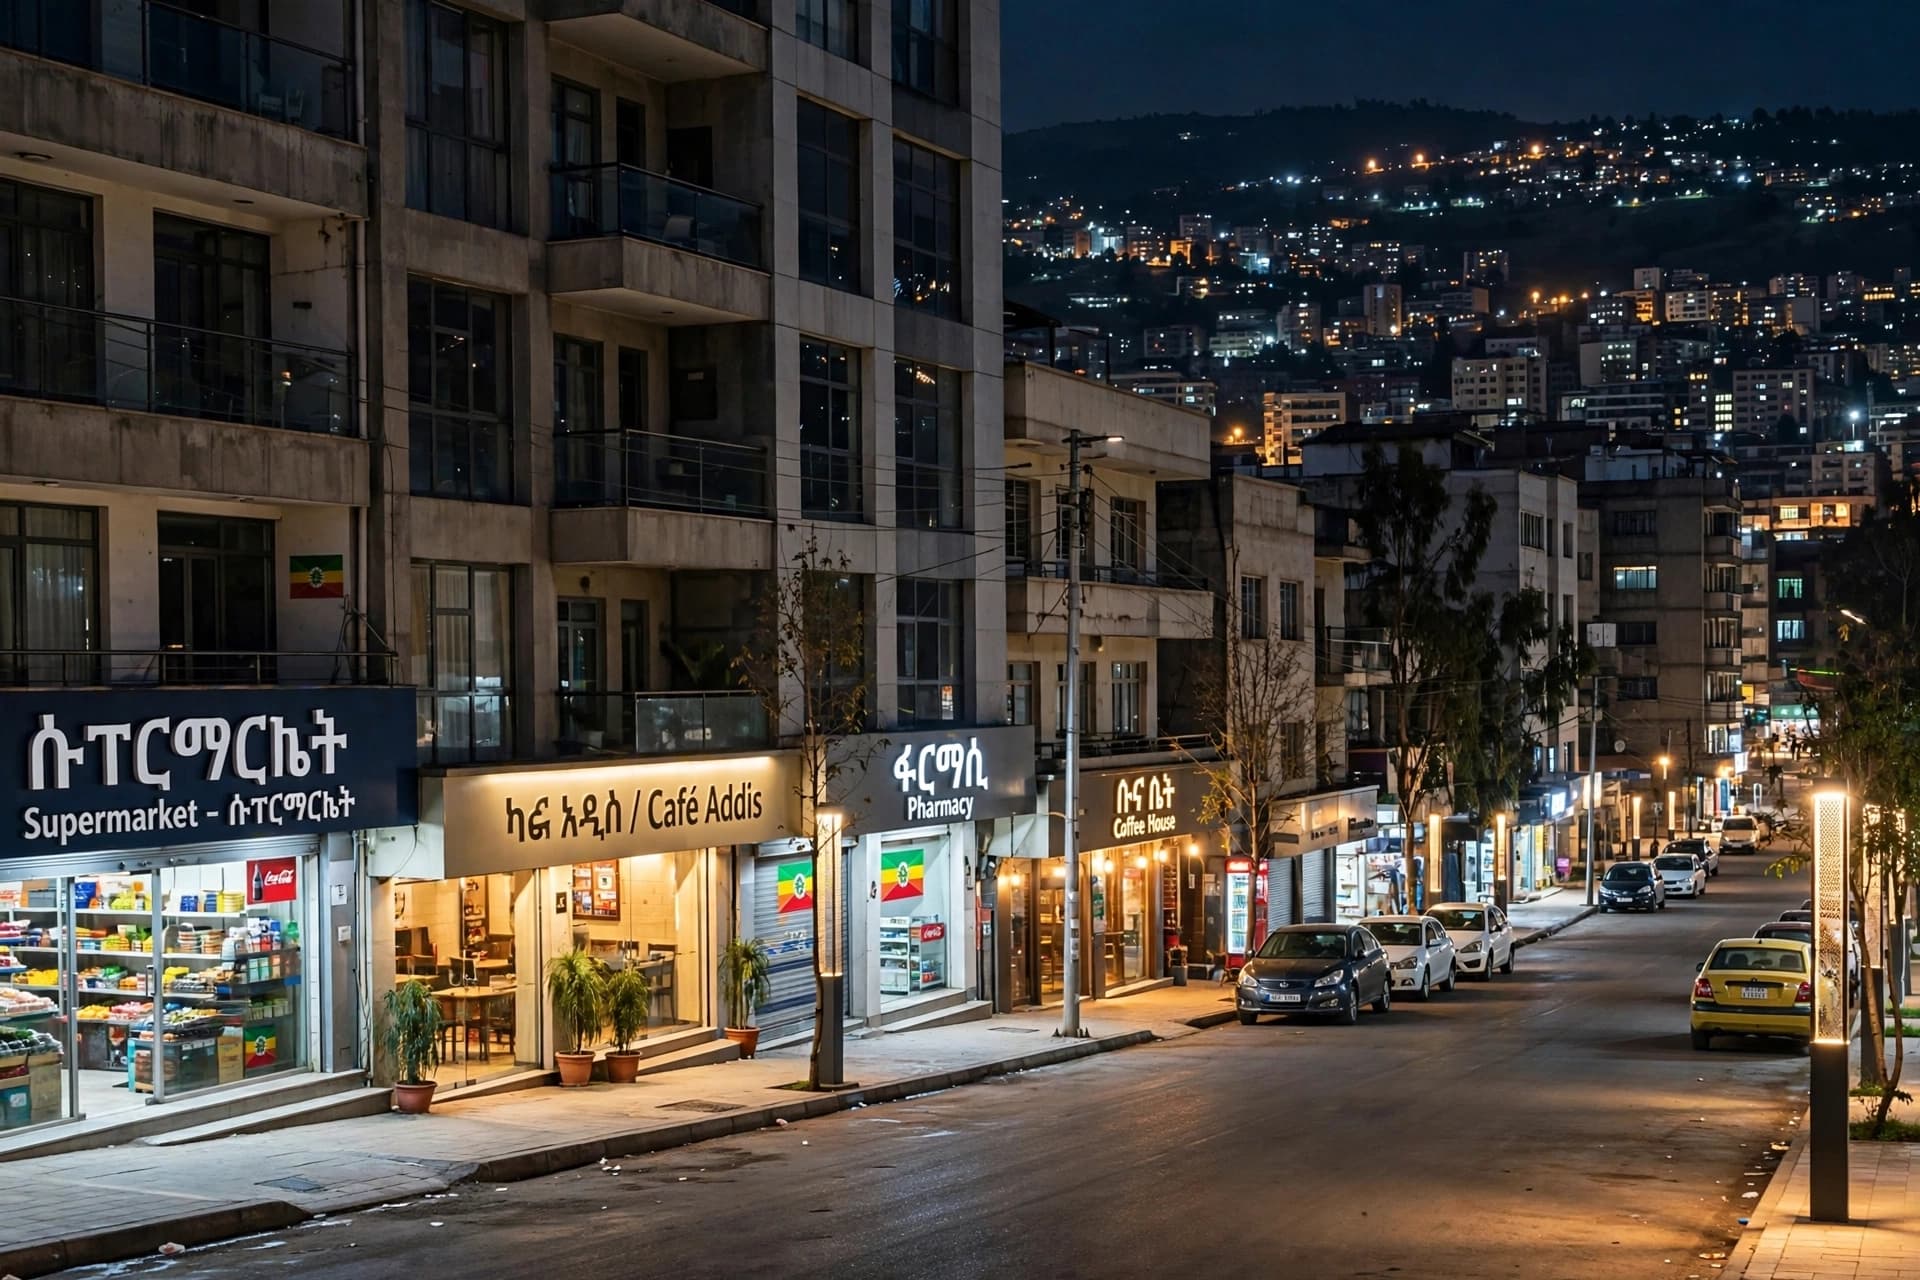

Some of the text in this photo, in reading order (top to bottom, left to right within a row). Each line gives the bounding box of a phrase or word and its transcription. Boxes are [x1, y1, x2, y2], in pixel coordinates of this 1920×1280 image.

[29, 709, 348, 791] ሱፐርማርኬት
[893, 736, 989, 796] ፋርማሲ
[24, 798, 199, 846] Supermarket
[229, 785, 356, 826] ሱፐርማርኬት
[560, 789, 622, 841] አዲስ
[647, 785, 699, 830] Café
[704, 781, 762, 824] Addis
[907, 795, 974, 821] Pharmacy
[1116, 772, 1176, 814] ቡና ቤት
[1113, 813, 1176, 839] Coffee House
